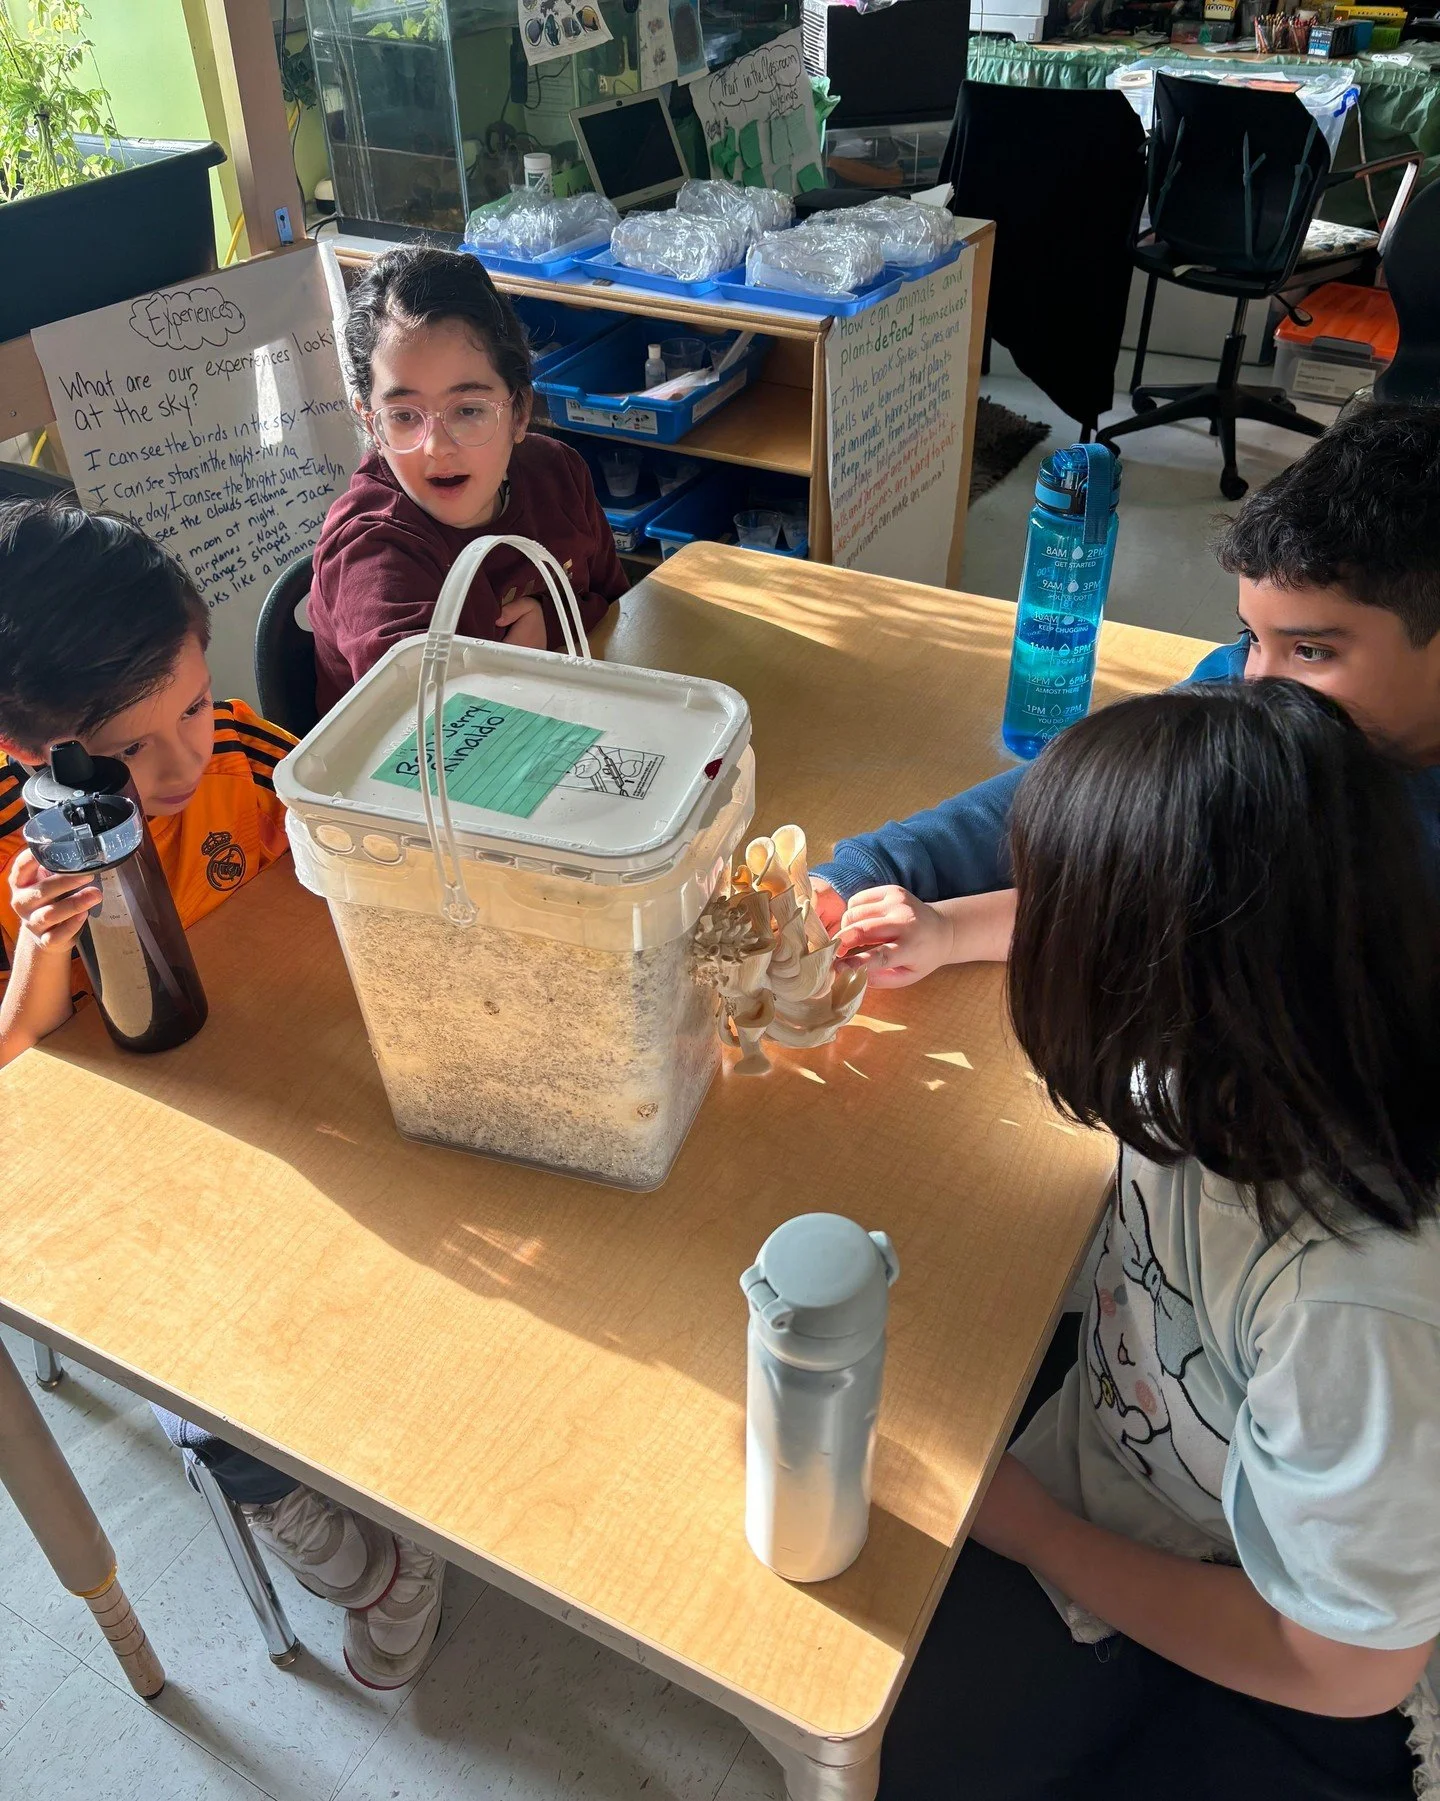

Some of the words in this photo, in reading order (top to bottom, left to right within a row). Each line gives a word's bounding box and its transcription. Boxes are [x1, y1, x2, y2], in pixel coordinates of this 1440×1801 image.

[743, 74, 752, 89] in
[145, 298, 234, 341] Experiences
[840, 316, 864, 340] How
[870, 304, 890, 326] can
[895, 282, 936, 315] animals
[942, 265, 963, 290] and
[59, 369, 115, 401] What
[126, 375, 152, 393] are
[168, 366, 193, 382] our
[206, 350, 290, 381] experiences
[292, 328, 346, 356] lookin
[840, 333, 873, 377] plants
[874, 314, 915, 352] defend
[75, 404, 104, 430] at
[113, 397, 154, 425] the
[158, 383, 198, 426] sky?
[831, 385, 848, 414] In
[850, 376, 869, 403] the
[871, 356, 894, 387] book
[861, 402, 874, 422] we
[909, 363, 926, 387] that
[84, 448, 102, 471] I
[108, 450, 139, 467] can
[140, 445, 165, 461] see
[165, 432, 190, 455] the
[189, 424, 228, 447] birds
[234, 423, 250, 438] in
[251, 413, 269, 434] the
[863, 438, 885, 465] them
[89, 484, 109, 507] I
[114, 482, 144, 498] can
[146, 475, 166, 492] see
[168, 463, 199, 485] stars
[199, 454, 211, 475] in
[209, 448, 228, 472] the
[129, 510, 146, 528] he
[165, 491, 182, 512] I
[182, 489, 205, 507] can
[204, 488, 223, 502] see
[223, 476, 243, 498] the
[244, 470, 277, 496] bright
[155, 525, 179, 543] see
[181, 515, 202, 530] the
[207, 497, 243, 519] clouds
[189, 535, 223, 558] moon
[225, 520, 241, 538] at
[195, 545, 241, 576] airplanes
[257, 521, 288, 544] Naya
[1046, 545, 1068, 558] 8AM
[1087, 546, 1106, 558] 2PM
[1069, 560, 1097, 568] STARTED
[196, 557, 247, 593] changes
[208, 591, 230, 609] oks
[232, 573, 257, 592] like
[263, 563, 272, 575] a
[1042, 579, 1063, 591] 9AM
[1083, 580, 1101, 591] 3PM
[1055, 624, 1089, 634] CHUGGING
[1073, 643, 1092, 655] 5PM
[1035, 686, 1062, 695] ALMOST
[1069, 673, 1087, 685] 6PM
[1027, 703, 1047, 715] 1PM
[1065, 703, 1083, 715] 7PM
